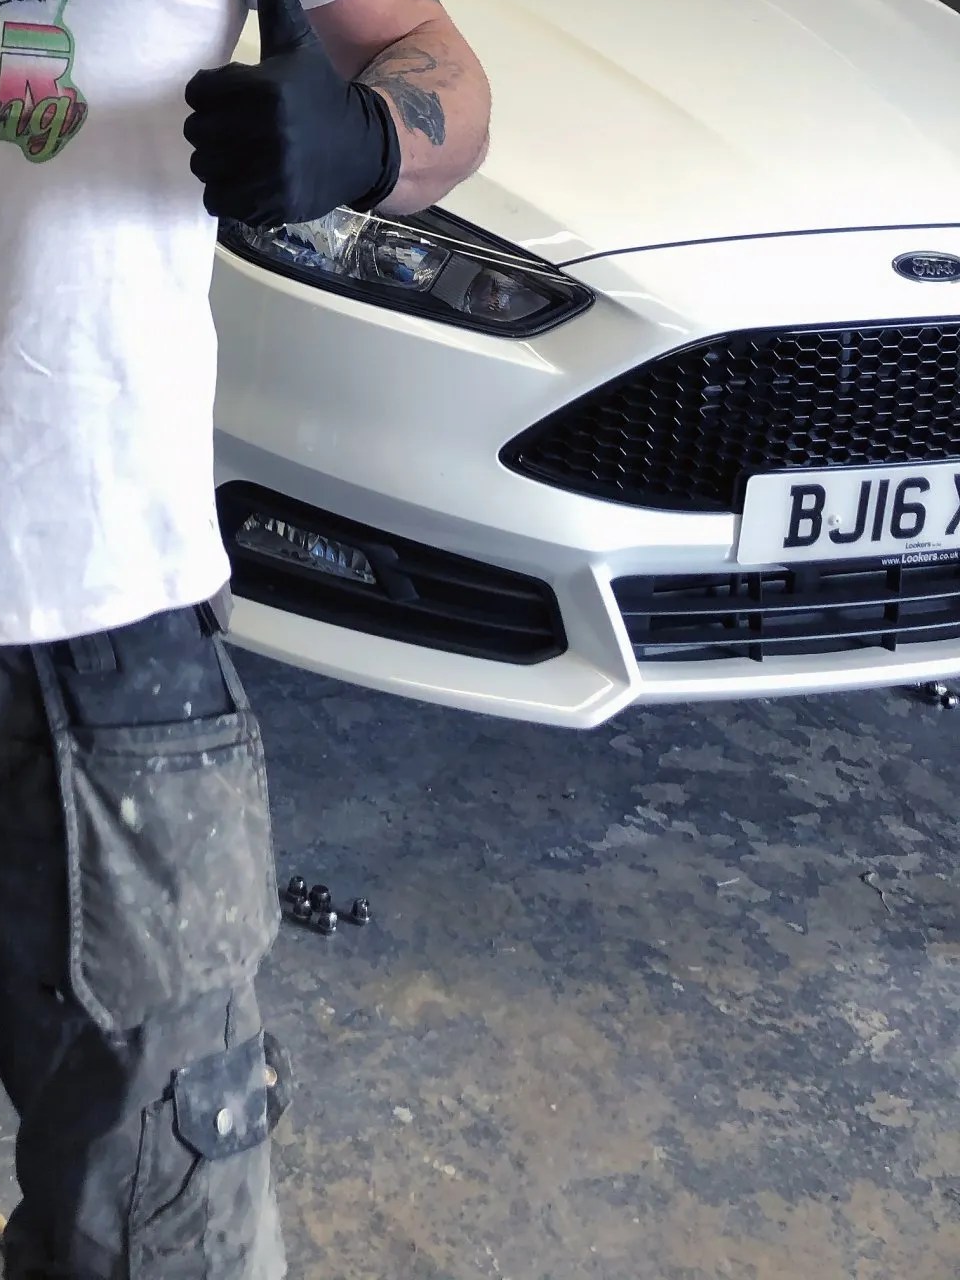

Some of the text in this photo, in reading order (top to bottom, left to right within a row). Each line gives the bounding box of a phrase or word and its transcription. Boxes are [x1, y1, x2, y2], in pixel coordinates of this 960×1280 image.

[912, 257, 957, 276] Ford
[783, 477, 930, 548] BJ16
[905, 541, 932, 549] Lookers
[881, 552, 959, 566] www.Lookers.co.uk
